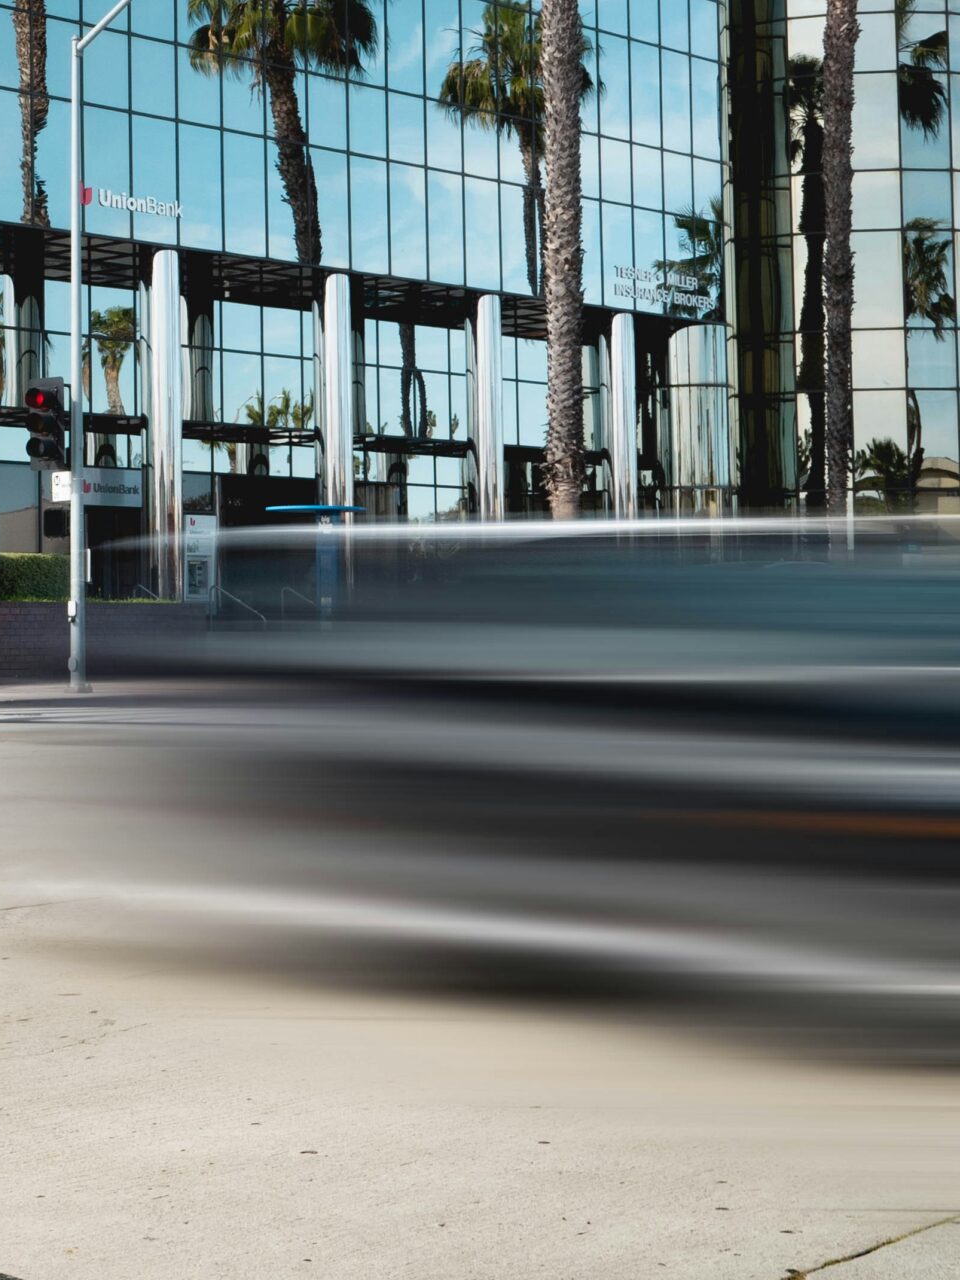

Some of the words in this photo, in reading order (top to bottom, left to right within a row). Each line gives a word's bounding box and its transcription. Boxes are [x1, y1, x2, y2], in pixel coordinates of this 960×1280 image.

[98, 188, 183, 218] UnionBank
[666, 271, 698, 290] MILLER
[614, 283, 668, 303] INSURANCE
[673, 291, 716, 310] BROKERS
[93, 482, 140, 495] UnionBank
